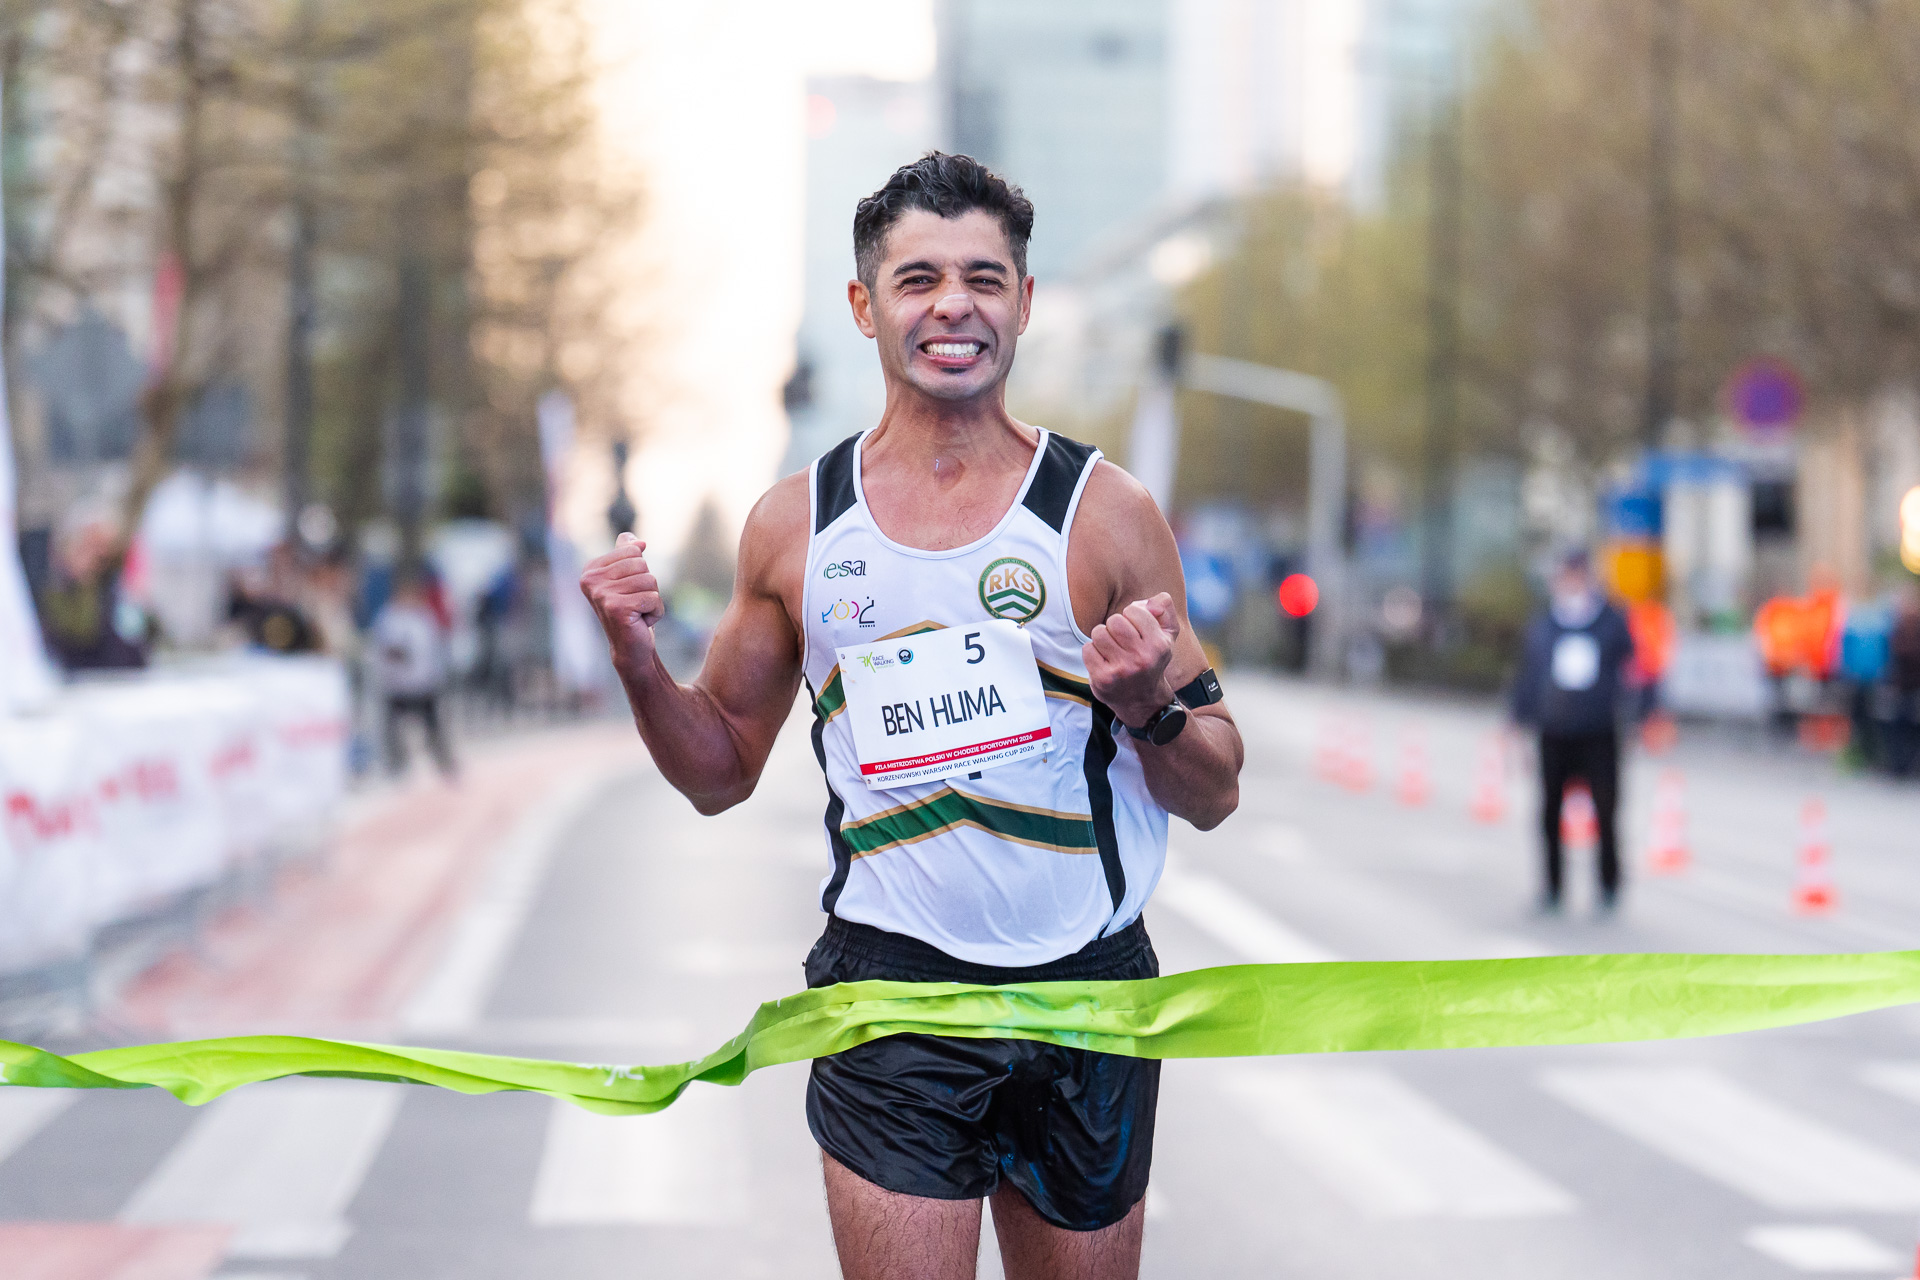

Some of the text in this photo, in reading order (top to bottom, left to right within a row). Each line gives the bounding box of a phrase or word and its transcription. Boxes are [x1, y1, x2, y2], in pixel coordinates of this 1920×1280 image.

[989, 567, 1035, 593] RKS
[964, 632, 986, 664] 5
[881, 684, 1007, 737] BEN HLIMA
[875, 763, 887, 771] PZLA
[886, 758, 925, 769] MISTRZOSTWA
[925, 753, 946, 763] POLSKI
[953, 745, 980, 757] CHODZIE
[980, 738, 1019, 751] SPORTOWYM
[1019, 734, 1033, 743] 2026
[877, 745, 1035, 782] KORZENIOWSKI WARSAW RACE WALKING CUP 2026
